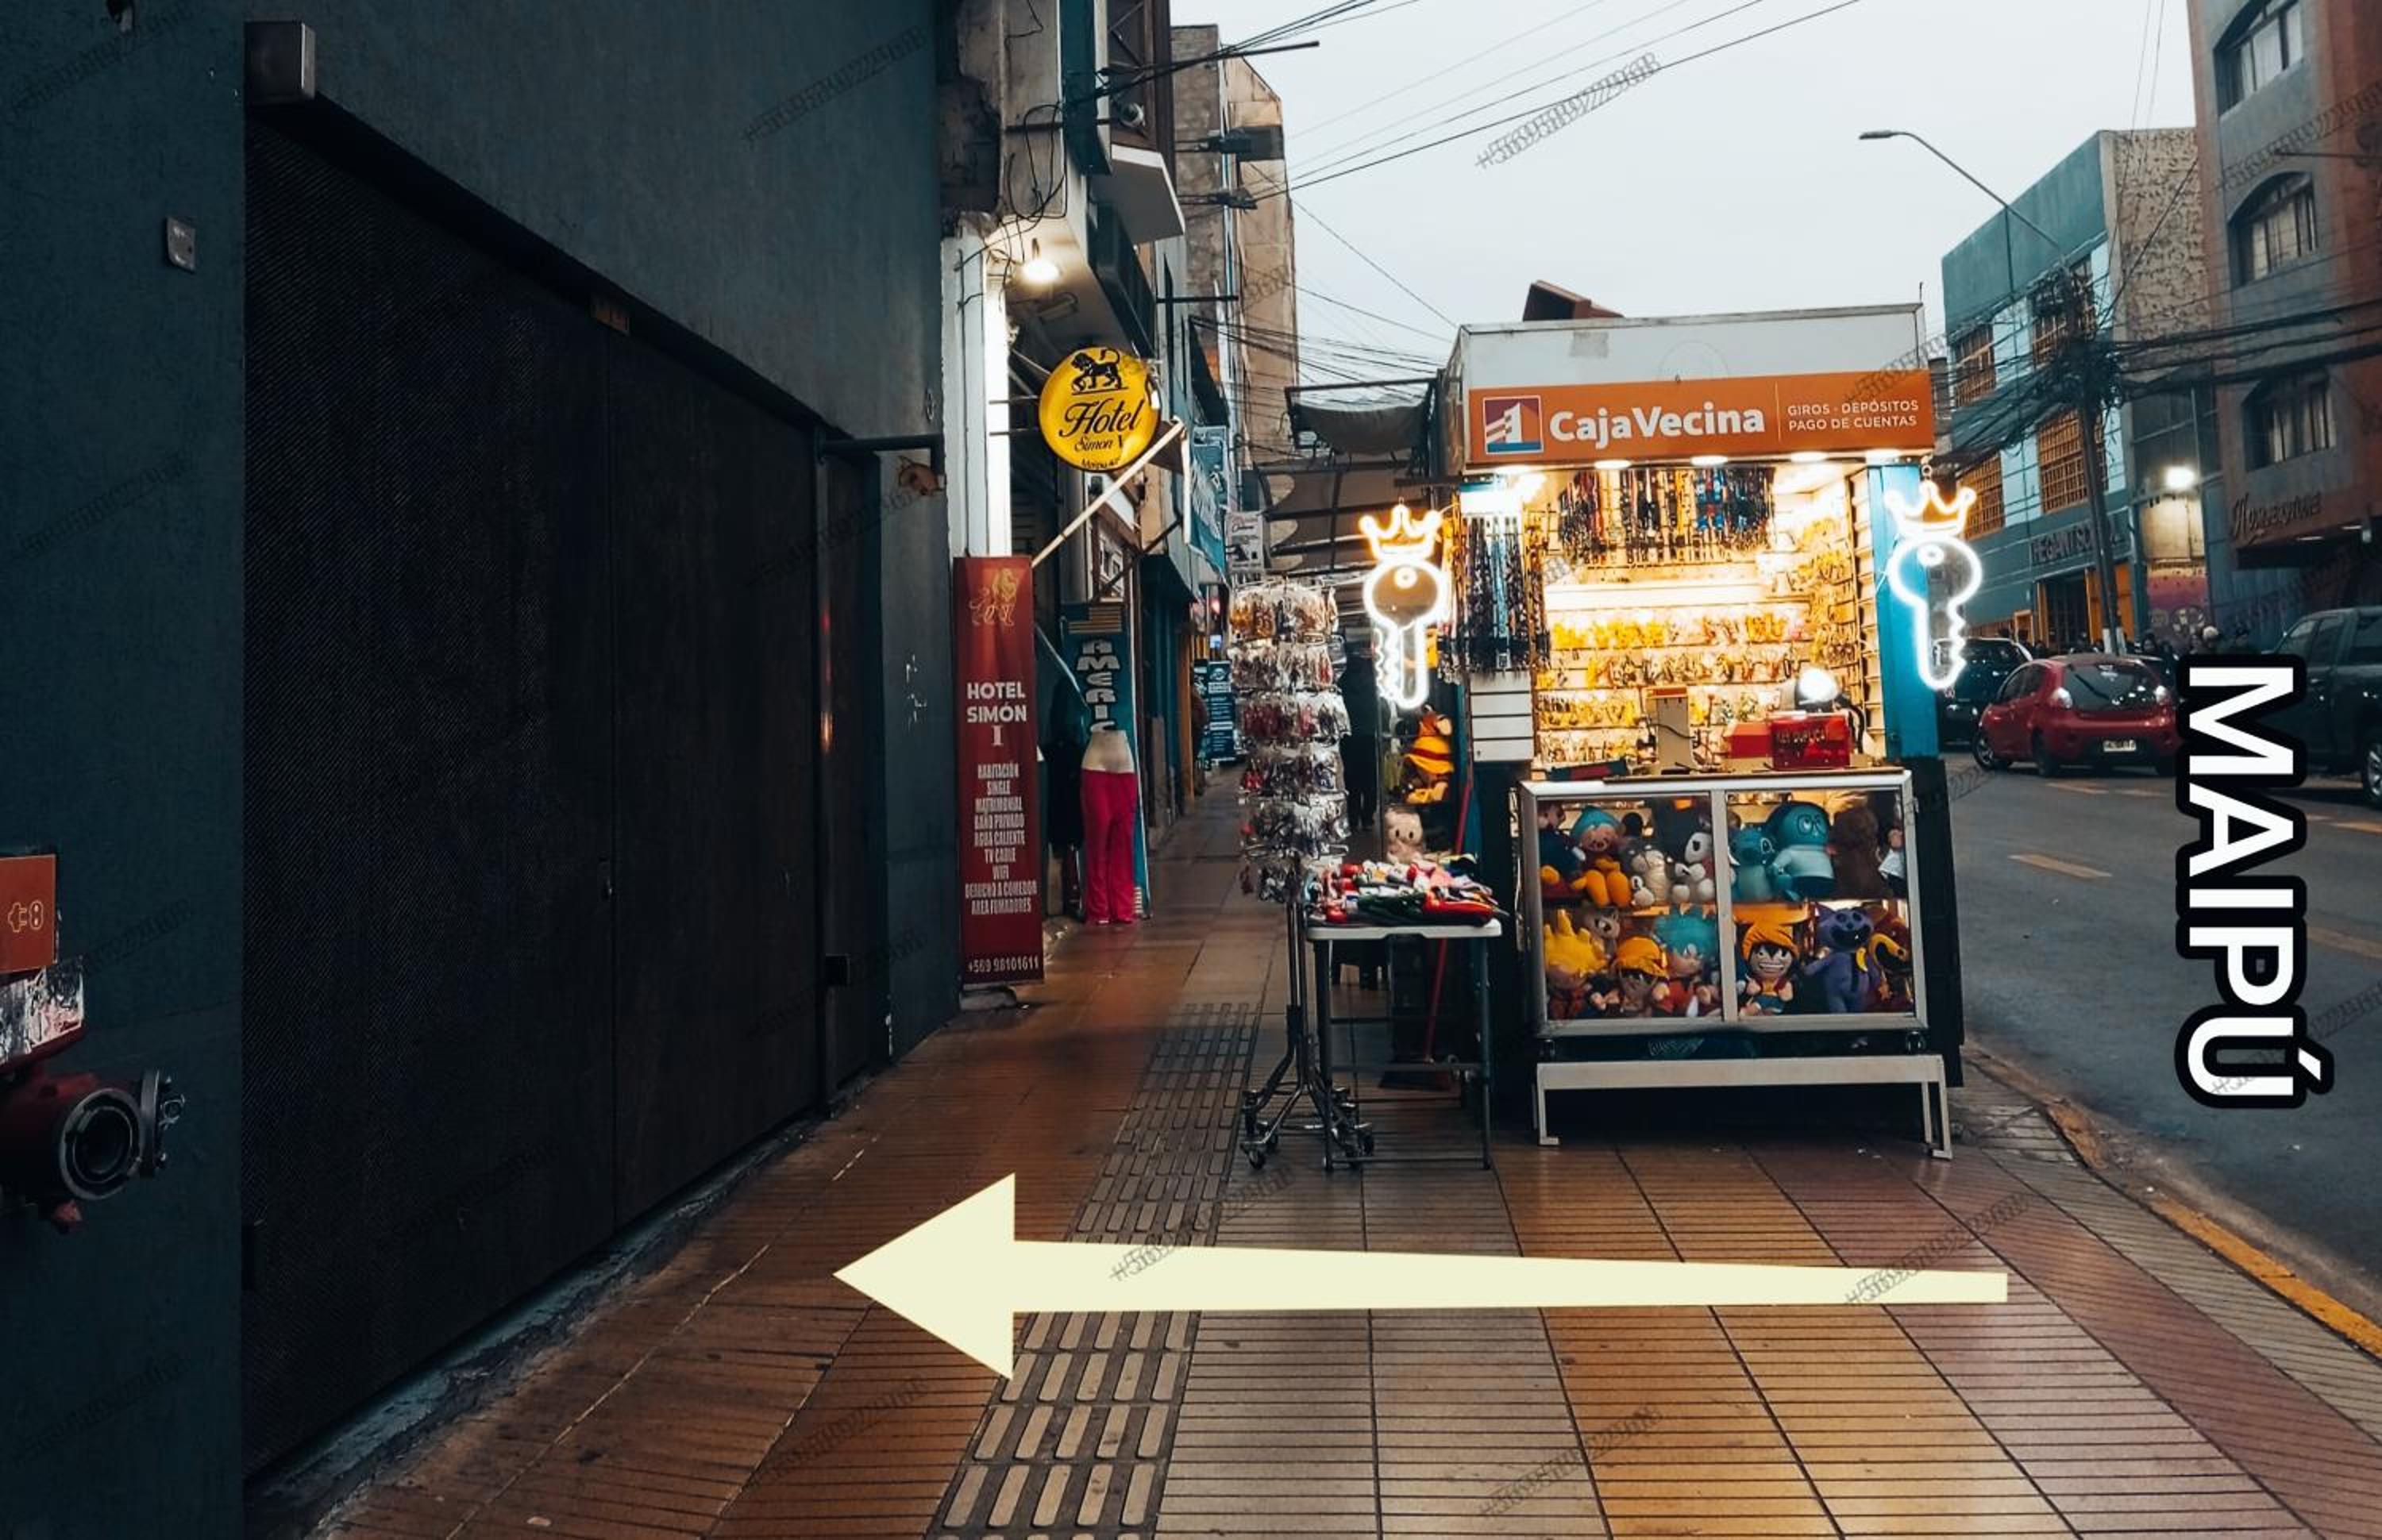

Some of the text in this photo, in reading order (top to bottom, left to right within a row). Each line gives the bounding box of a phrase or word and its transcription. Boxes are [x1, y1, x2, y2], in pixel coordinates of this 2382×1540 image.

[1787, 398, 1919, 417] GIROS DEPÓSITOS
[1059, 398, 1144, 437] Hotel
[1789, 414, 1917, 432] PAGO DE CUENTAS
[966, 681, 1026, 699] HOTEL
[966, 702, 1027, 723] SIMÓN
[991, 725, 1004, 746] I
[993, 830, 1025, 846] CALIENTE
[985, 849, 994, 864] TV
